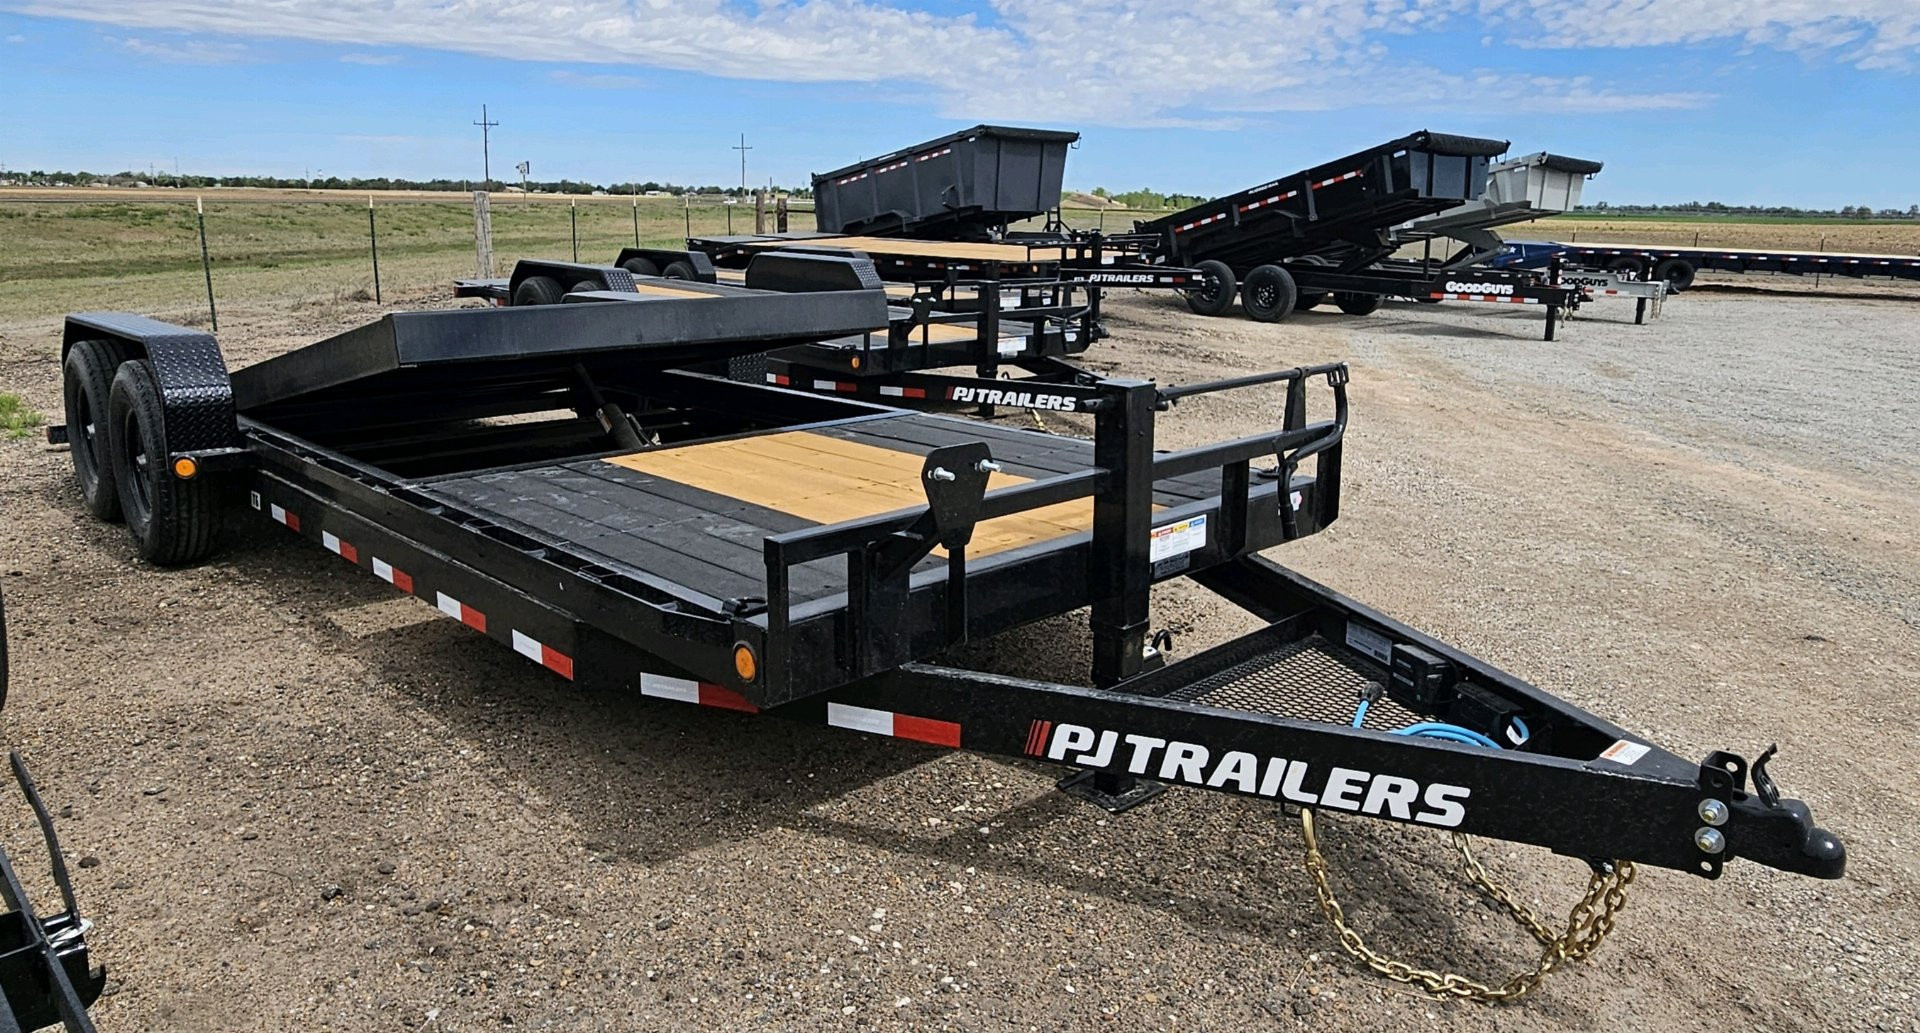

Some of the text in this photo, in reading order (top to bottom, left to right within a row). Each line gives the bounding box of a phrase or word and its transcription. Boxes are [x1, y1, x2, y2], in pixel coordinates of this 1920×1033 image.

[1088, 273, 1102, 283] PJ
[1101, 274, 1155, 283] TRAILERS
[952, 386, 1077, 412] PJ TRAILERS
[1047, 723, 1472, 827] PJ TRAILERS
